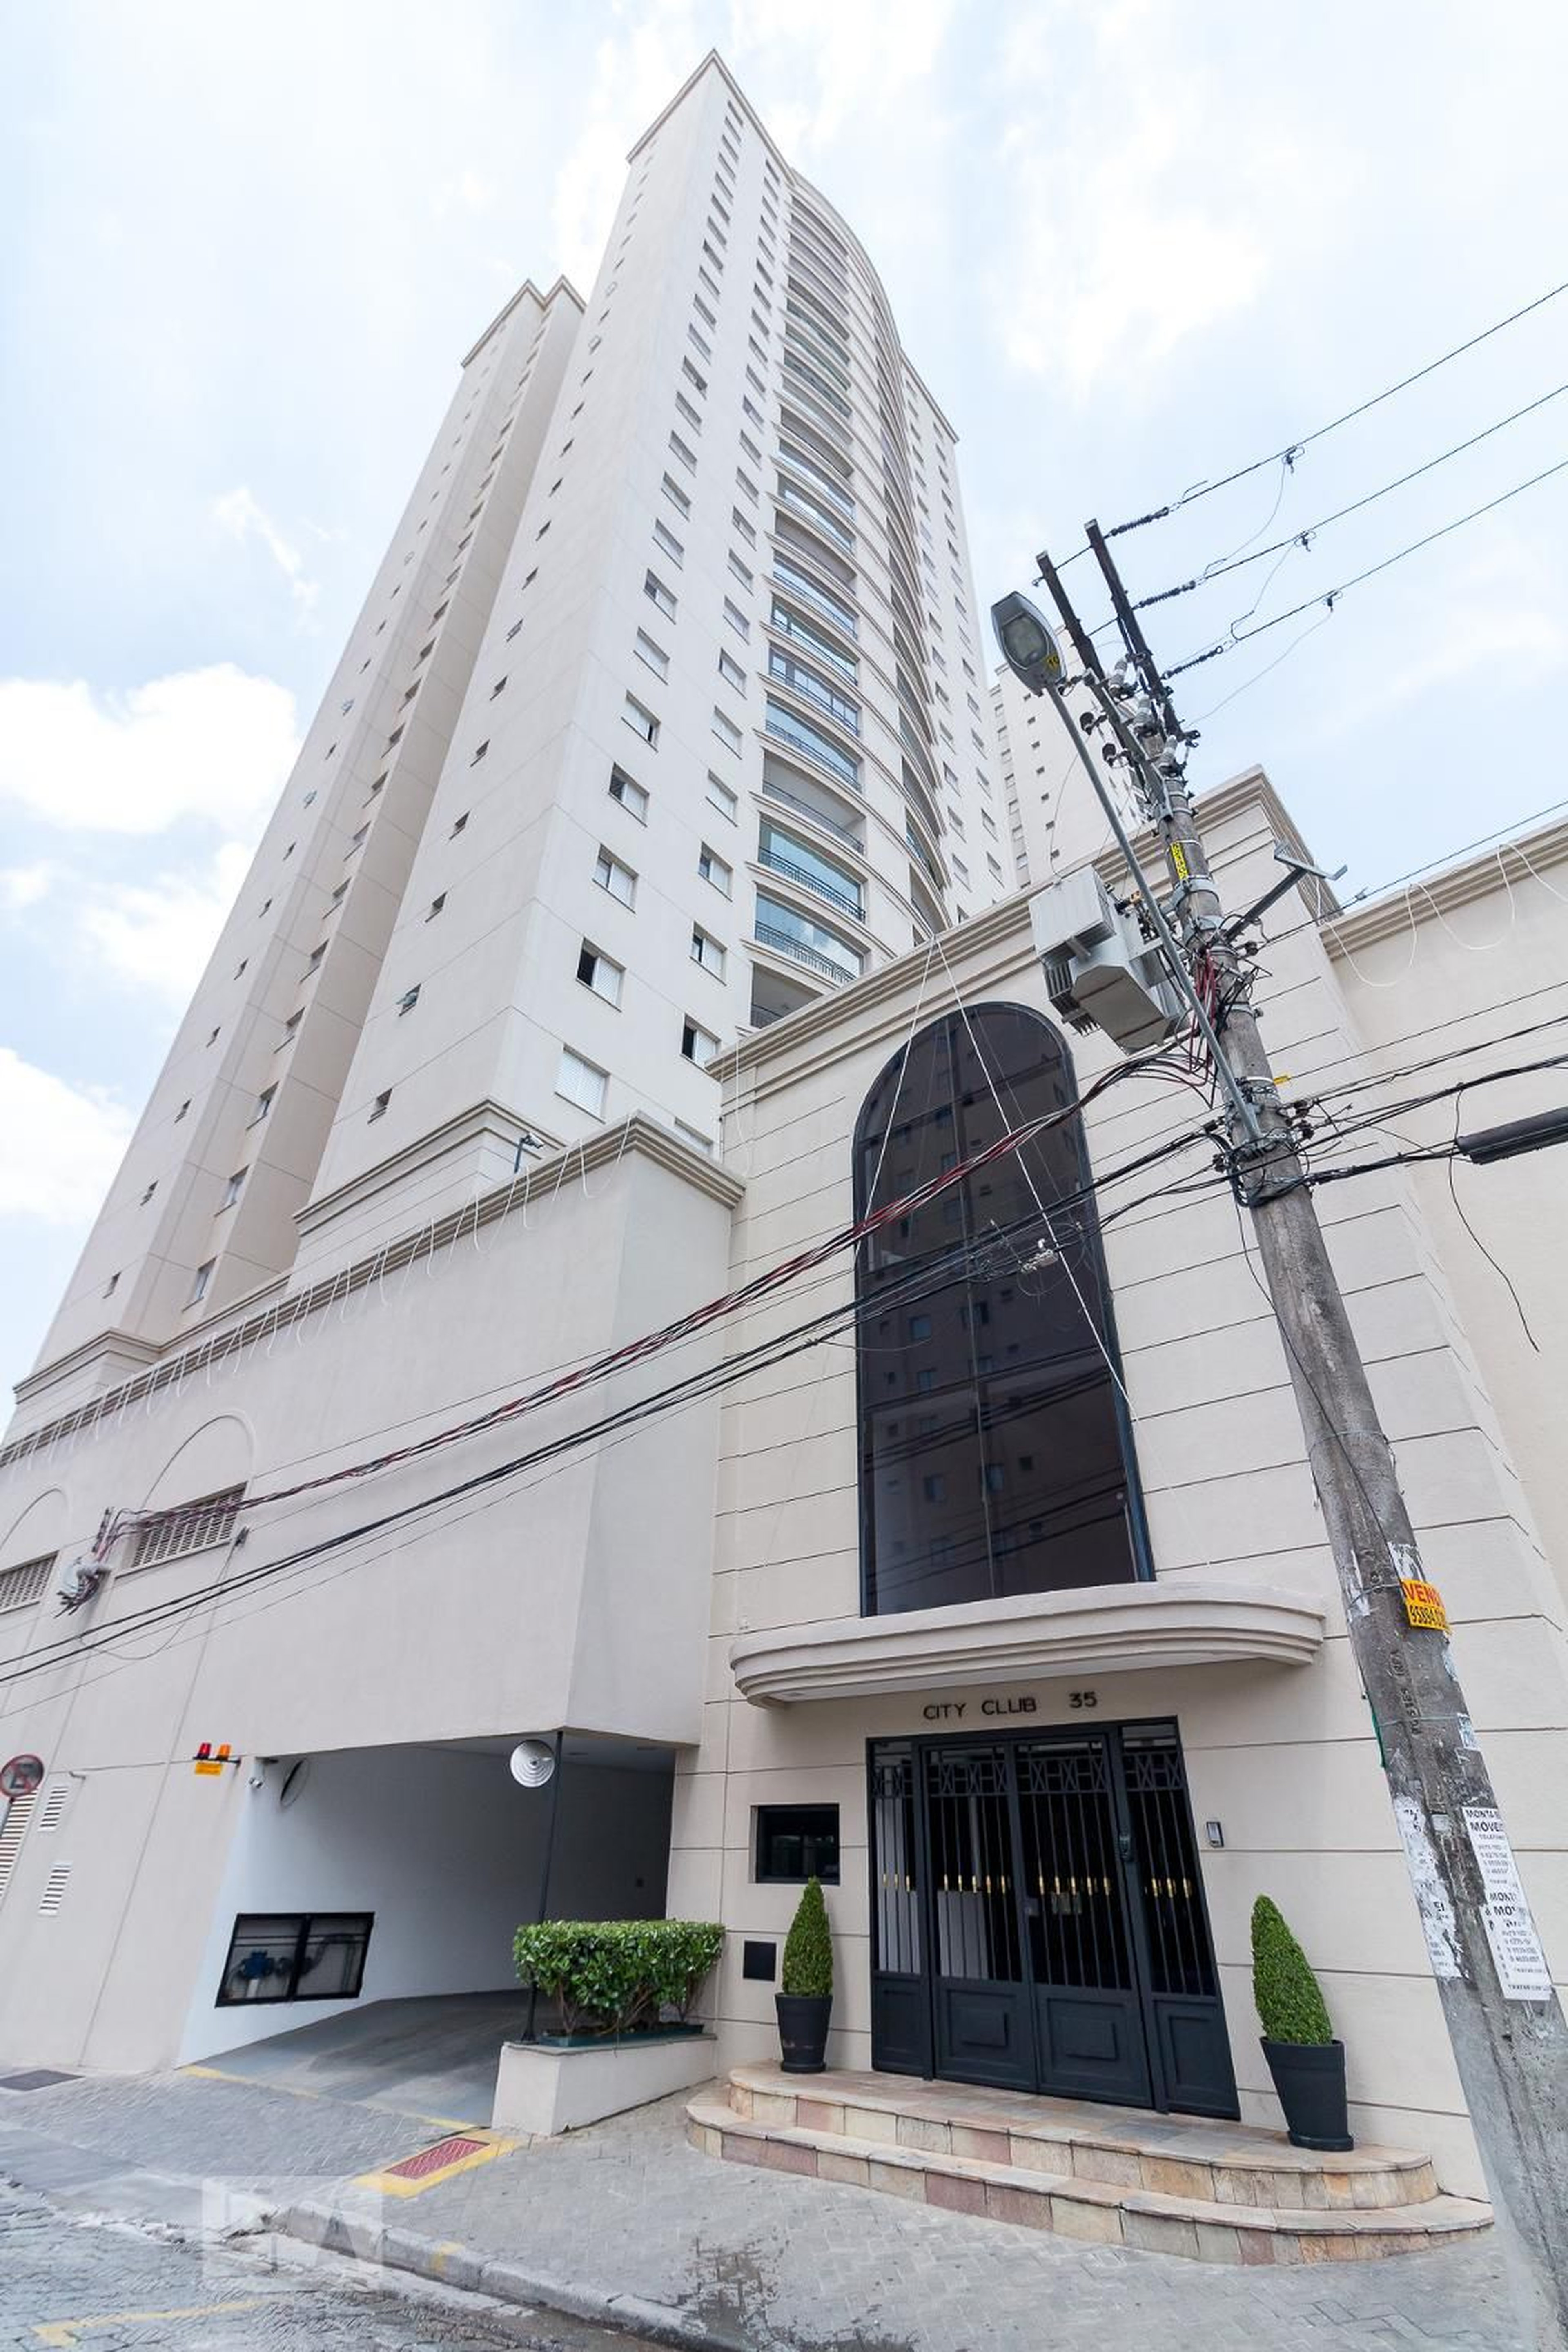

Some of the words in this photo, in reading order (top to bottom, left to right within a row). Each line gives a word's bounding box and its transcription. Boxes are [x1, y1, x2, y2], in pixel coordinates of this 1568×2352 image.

[923, 1702, 967, 1720] CITY
[981, 1697, 1037, 1715] CLUB
[1069, 1691, 1098, 1708] 35
